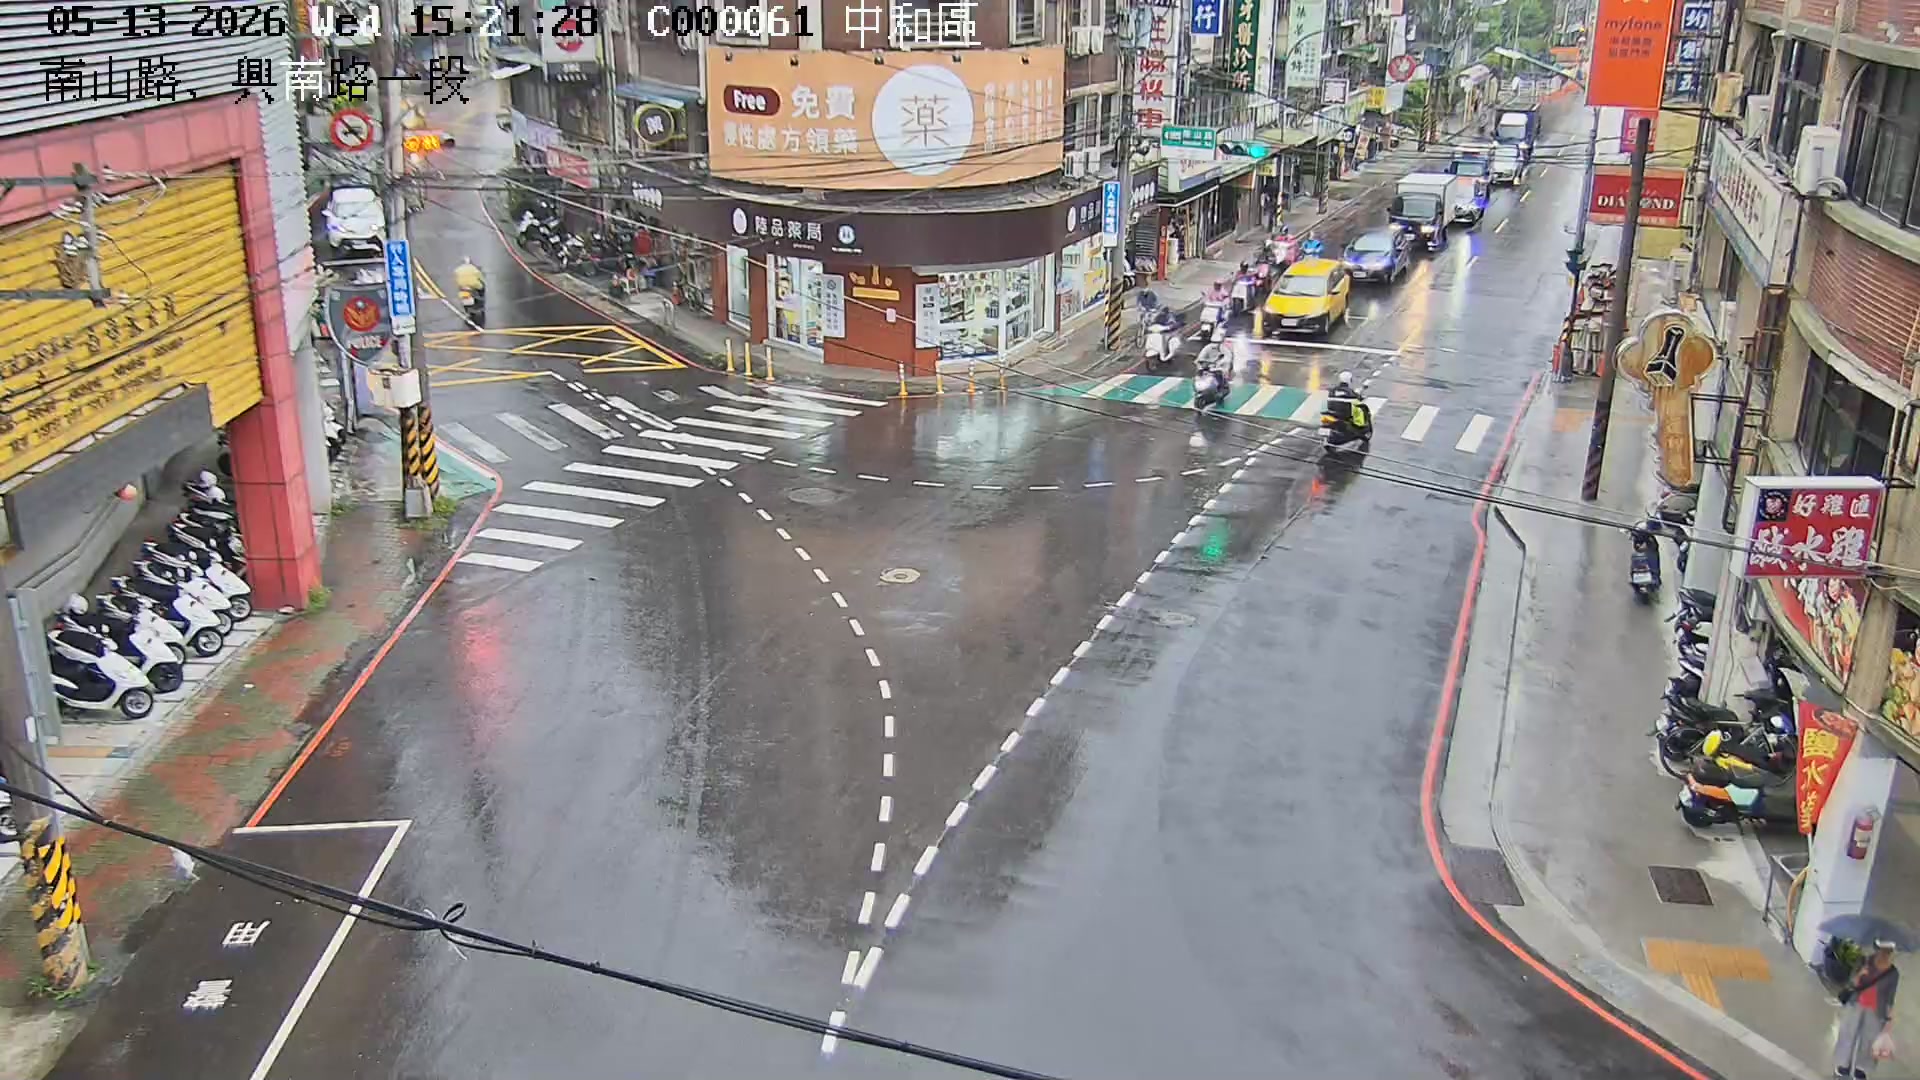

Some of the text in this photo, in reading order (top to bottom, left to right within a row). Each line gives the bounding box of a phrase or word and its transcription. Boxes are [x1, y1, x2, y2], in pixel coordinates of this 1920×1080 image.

[1605, 16, 1662, 32] myfone
[733, 89, 767, 112] Free
[791, 84, 856, 121] 免費
[1597, 195, 1675, 210] DIAOND
